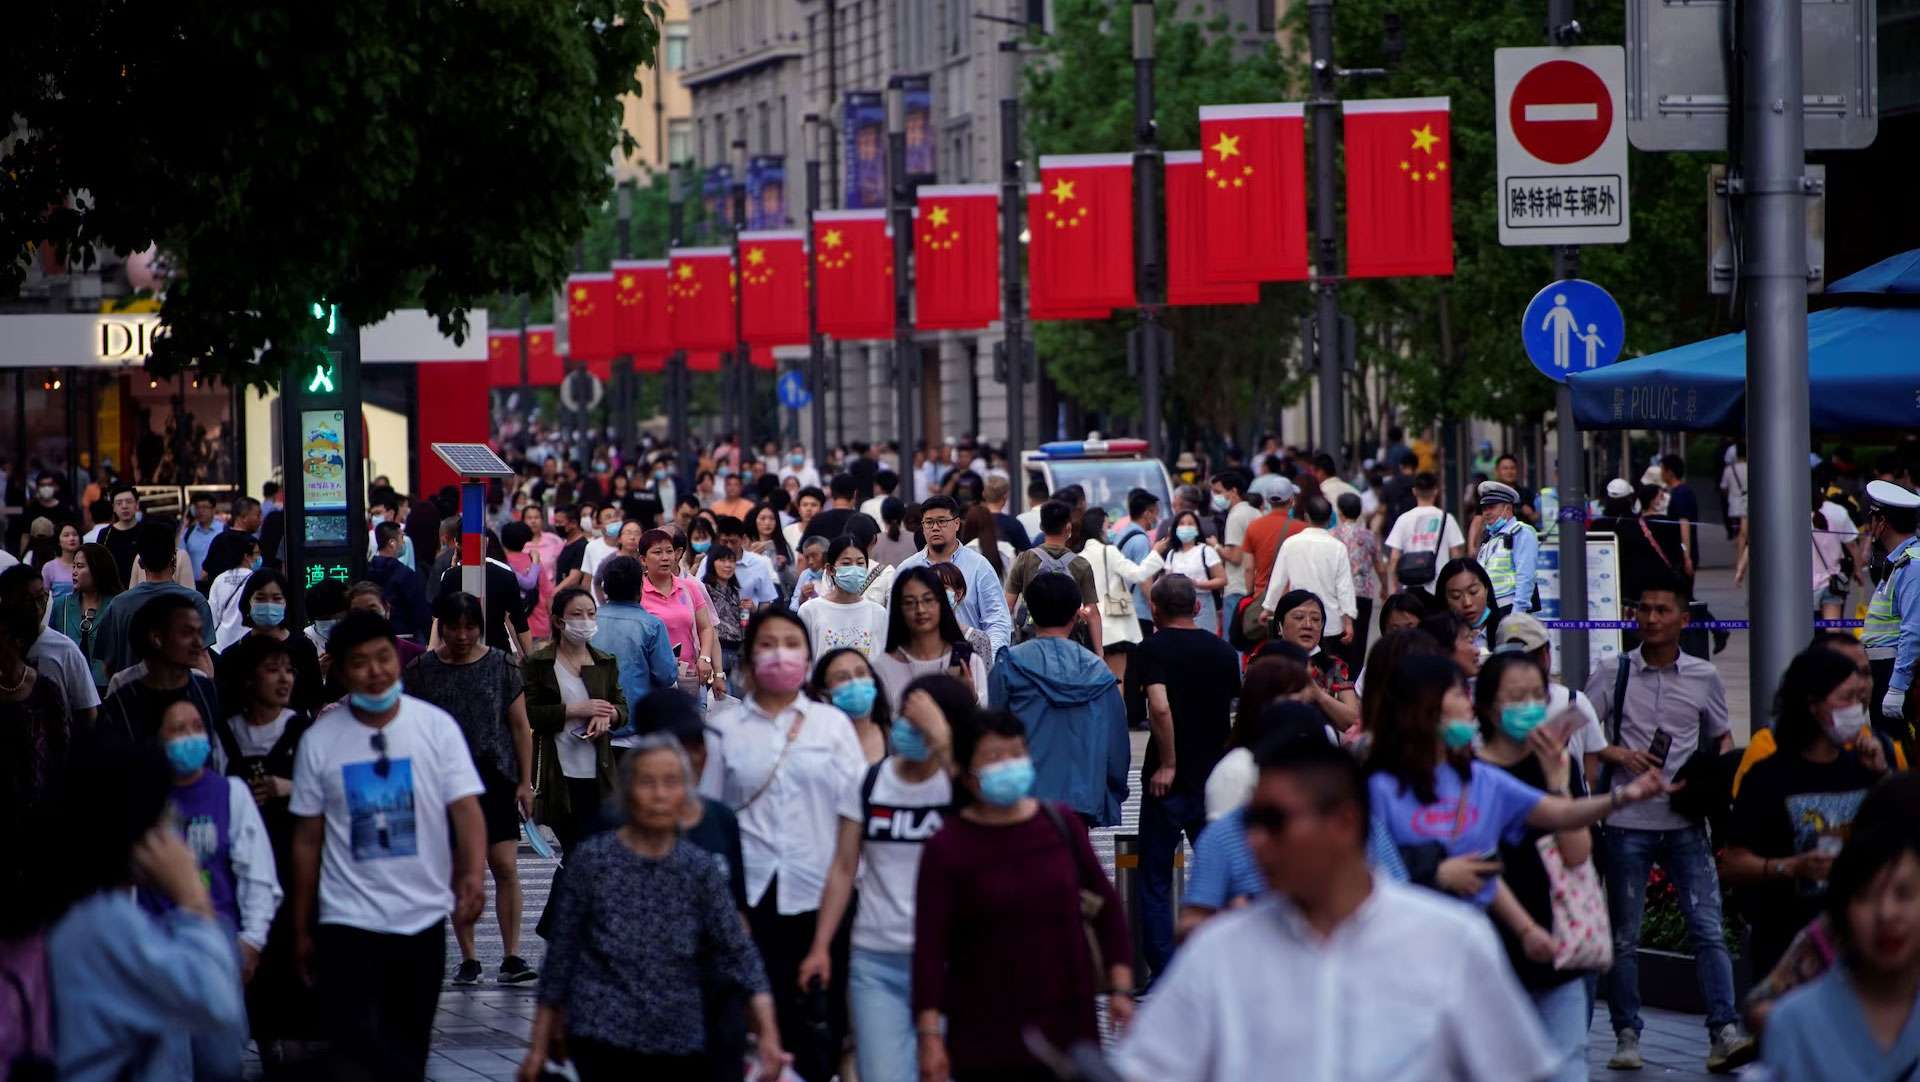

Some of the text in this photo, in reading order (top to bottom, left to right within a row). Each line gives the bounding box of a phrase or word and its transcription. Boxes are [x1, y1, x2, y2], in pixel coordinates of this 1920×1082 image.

[1511, 185, 1615, 218] 除特种车辆外
[1631, 385, 1680, 421] POLICE
[305, 564, 349, 589] 遵守
[867, 806, 944, 840] FILA
